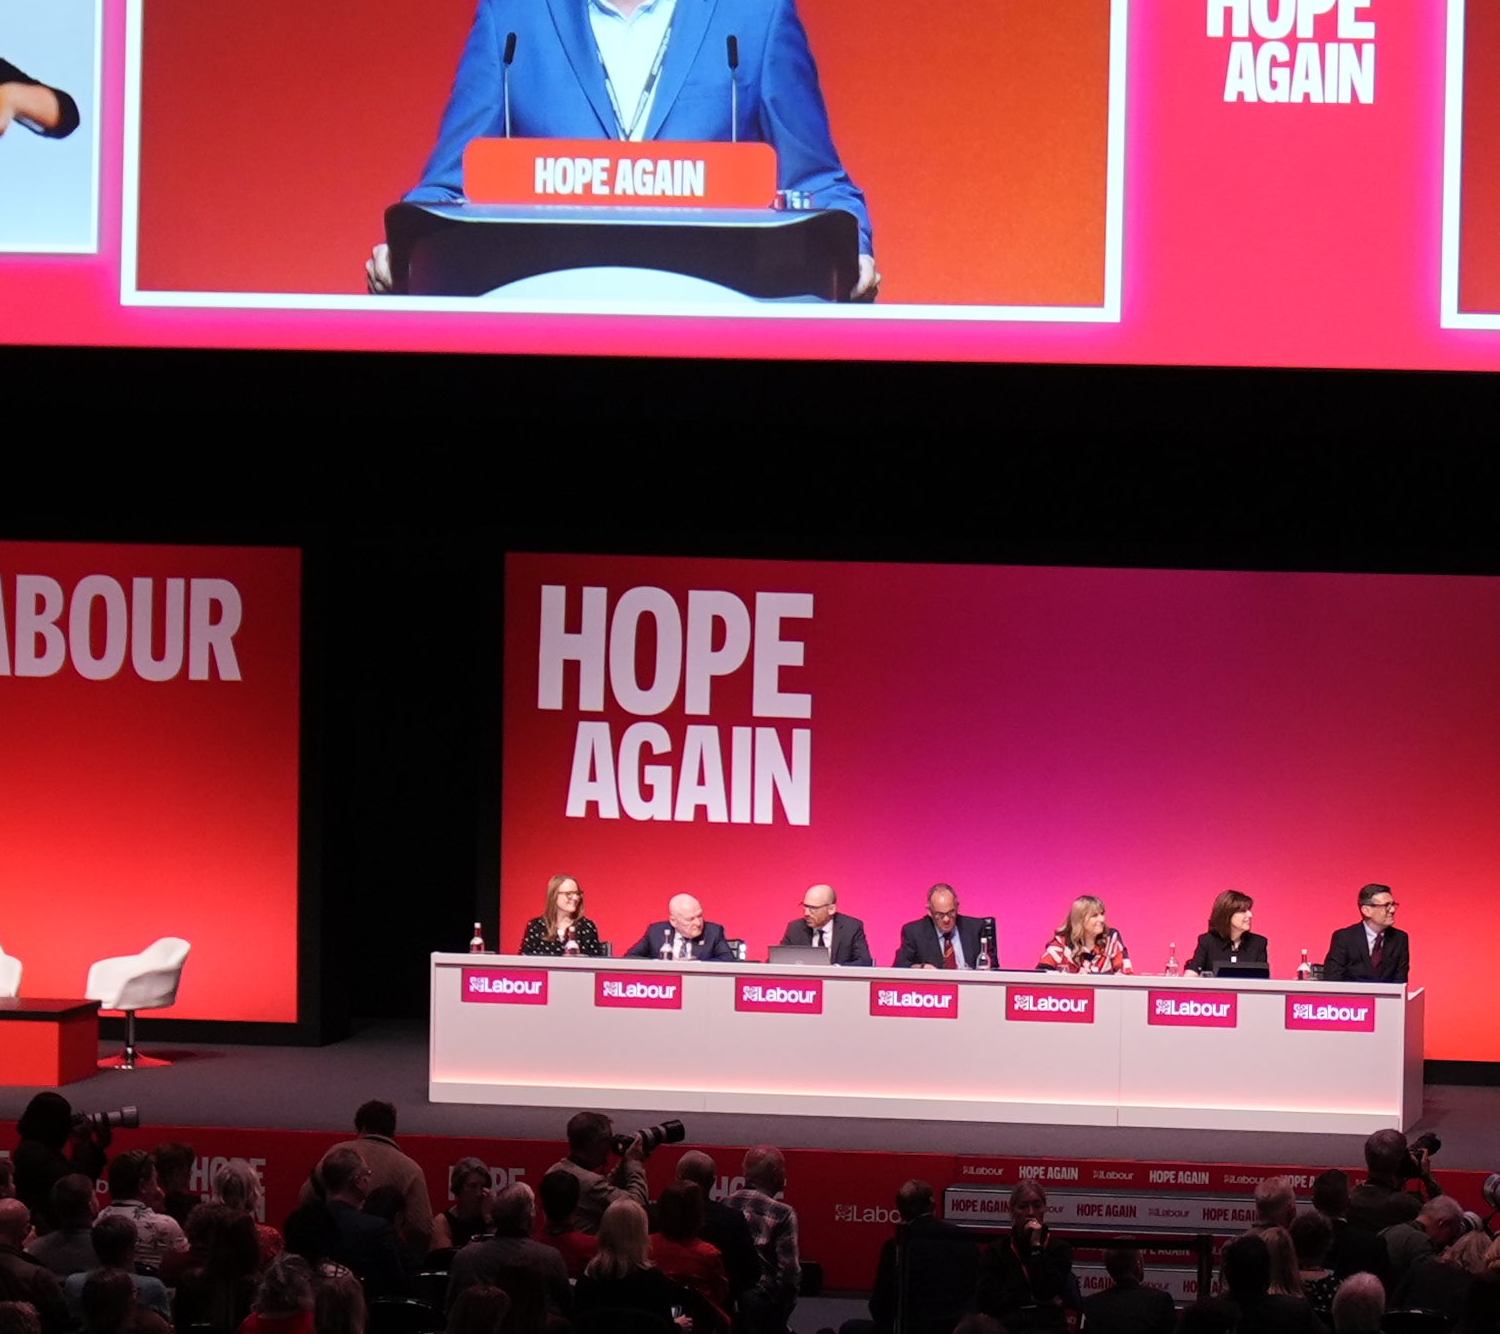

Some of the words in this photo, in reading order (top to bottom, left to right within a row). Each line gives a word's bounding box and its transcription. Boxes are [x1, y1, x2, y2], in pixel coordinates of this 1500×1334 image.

[1223, 39, 1376, 105] AGAIN
[534, 157, 610, 195] HOPE
[614, 159, 705, 197] AGAIN
[537, 585, 814, 719] HOPE
[565, 721, 812, 826] AGAIN
[483, 977, 542, 995] Labour
[617, 981, 677, 999] Labour
[756, 986, 817, 1004] Labour
[892, 990, 952, 1008] Labour
[1028, 995, 1088, 1013] Labour
[1170, 999, 1231, 1017] Labour
[1305, 1004, 1369, 1022] Labour
[1018, 1166, 1046, 1179] HOPE
[1047, 1167, 1079, 1181] AGAIN
[1149, 1169, 1176, 1183] HOPE
[1177, 1171, 1210, 1185] AGAIN
[853, 1205, 901, 1223] Labo
[951, 1199, 978, 1212] HOPE
[1076, 1203, 1103, 1216] HOPE
[1105, 1205, 1137, 1217] AGAIN
[1202, 1208, 1229, 1221] HOPE
[1230, 1210, 1256, 1222] AGAI
